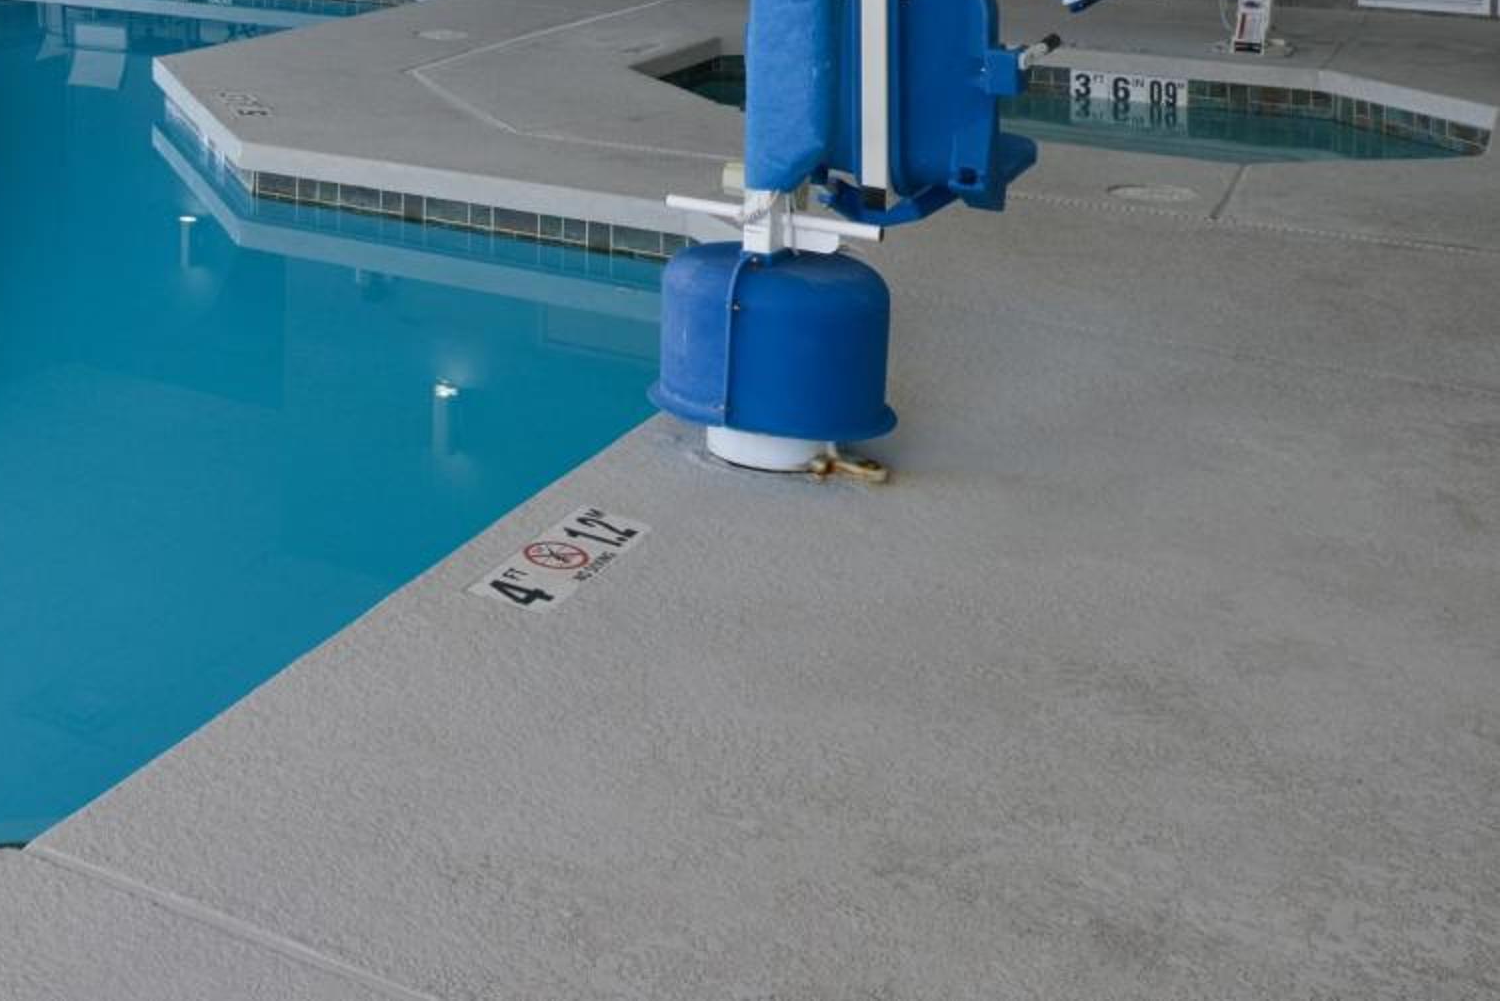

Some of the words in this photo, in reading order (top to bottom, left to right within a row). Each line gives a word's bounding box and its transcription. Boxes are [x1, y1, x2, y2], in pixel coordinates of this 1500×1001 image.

[1075, 73, 1091, 98] 3
[1112, 77, 1130, 102] 6
[489, 579, 555, 606] 4
[564, 515, 641, 548] 1.2
